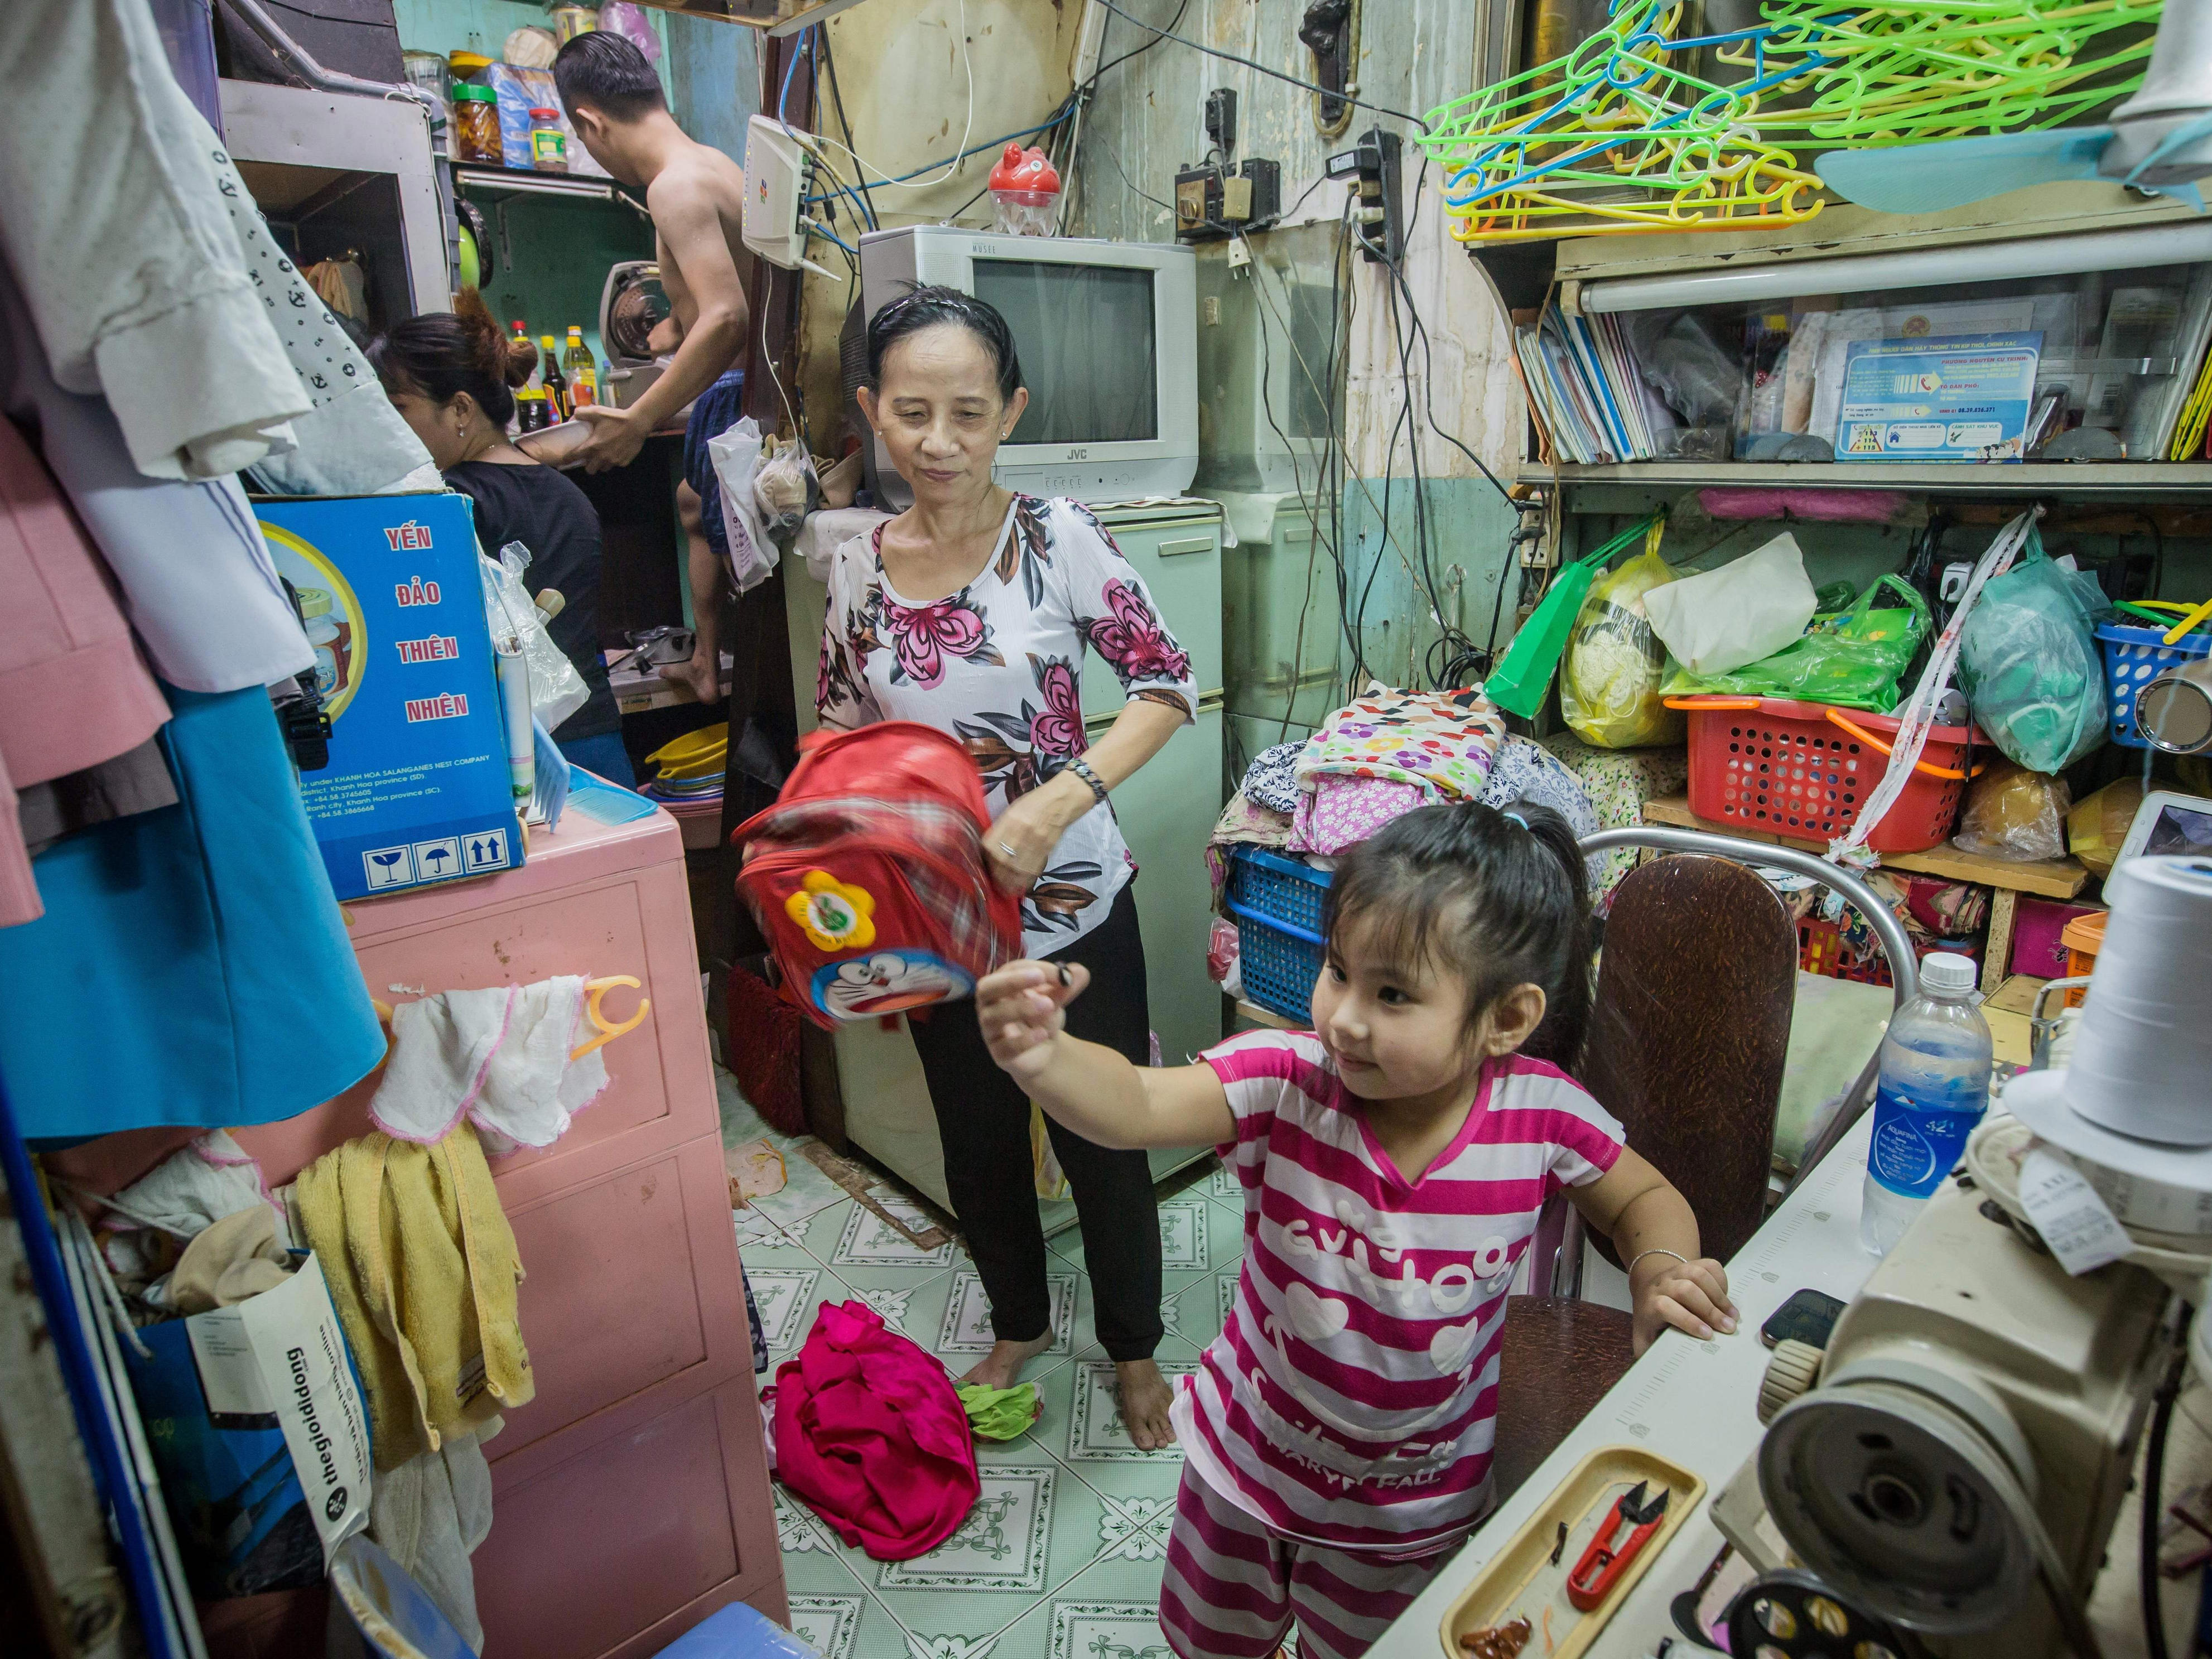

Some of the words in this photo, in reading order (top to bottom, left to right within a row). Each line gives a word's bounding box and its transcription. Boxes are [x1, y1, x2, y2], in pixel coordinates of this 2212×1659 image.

[1067, 449, 1087, 460] JVC
[385, 520, 432, 551] YẾN
[397, 576, 440, 607] ĐẢO
[397, 635, 459, 664] THIÊN
[406, 693, 469, 722] NHIÊN
[335, 774, 362, 783] KHANH
[383, 764, 433, 776] SALANGANES
[454, 755, 490, 766] COMPANY
[375, 776, 407, 787] province
[346, 798, 371, 806] Khanh
[391, 790, 423, 800] province
[320, 1324, 334, 1364] online
[287, 1347, 338, 1486] thegioididong
